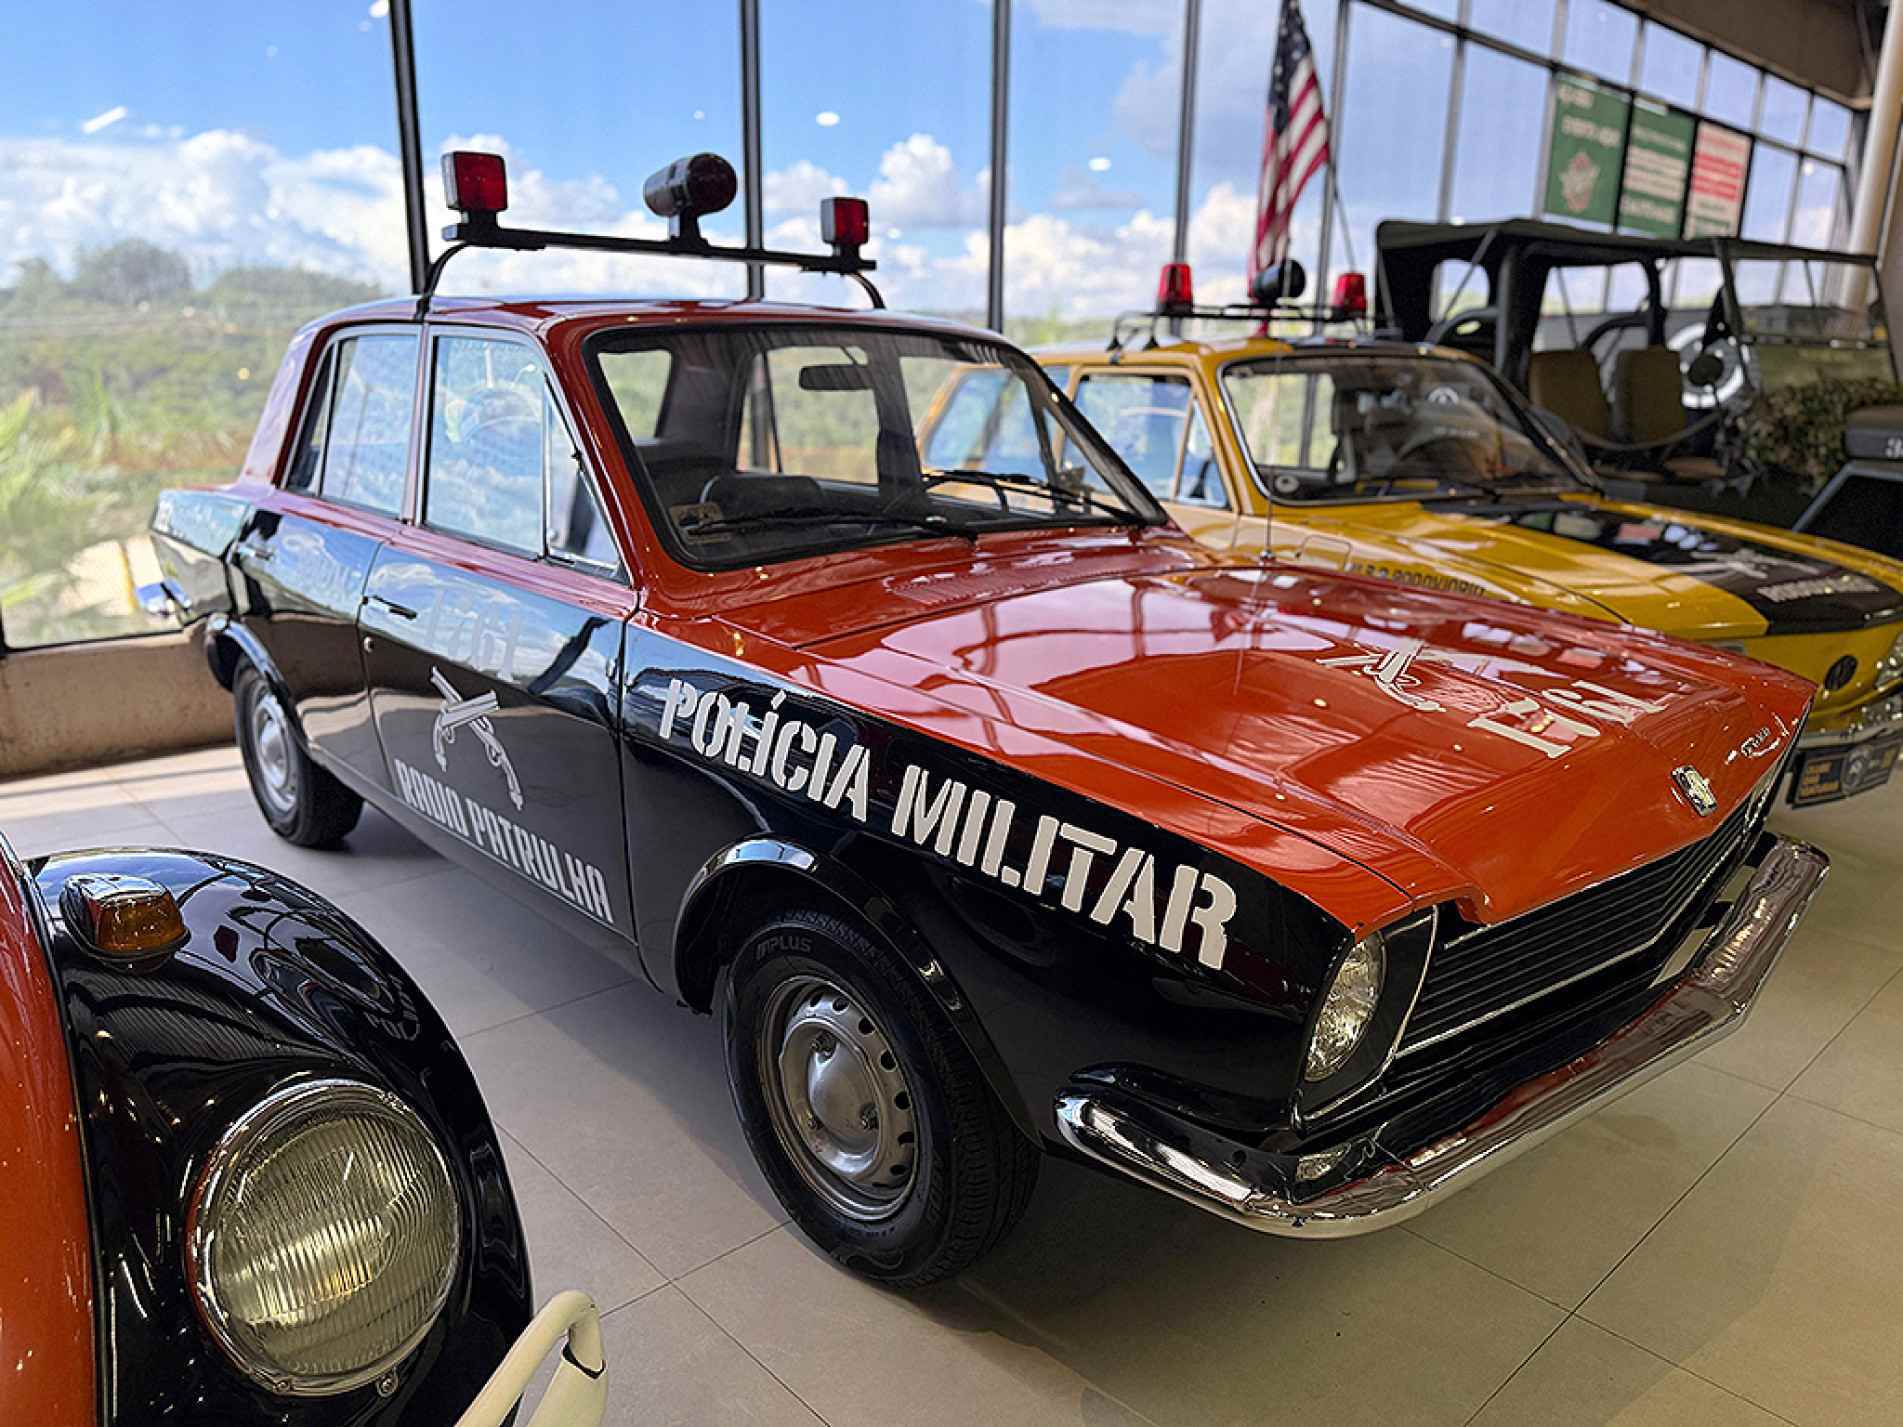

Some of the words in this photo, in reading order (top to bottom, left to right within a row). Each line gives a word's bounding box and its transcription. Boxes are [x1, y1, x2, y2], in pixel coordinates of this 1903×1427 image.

[394, 758, 469, 838] RADIO
[465, 797, 614, 923] PATRULHA
[659, 678, 871, 823] POLÍCIA
[891, 764, 1238, 970] MILITAR
